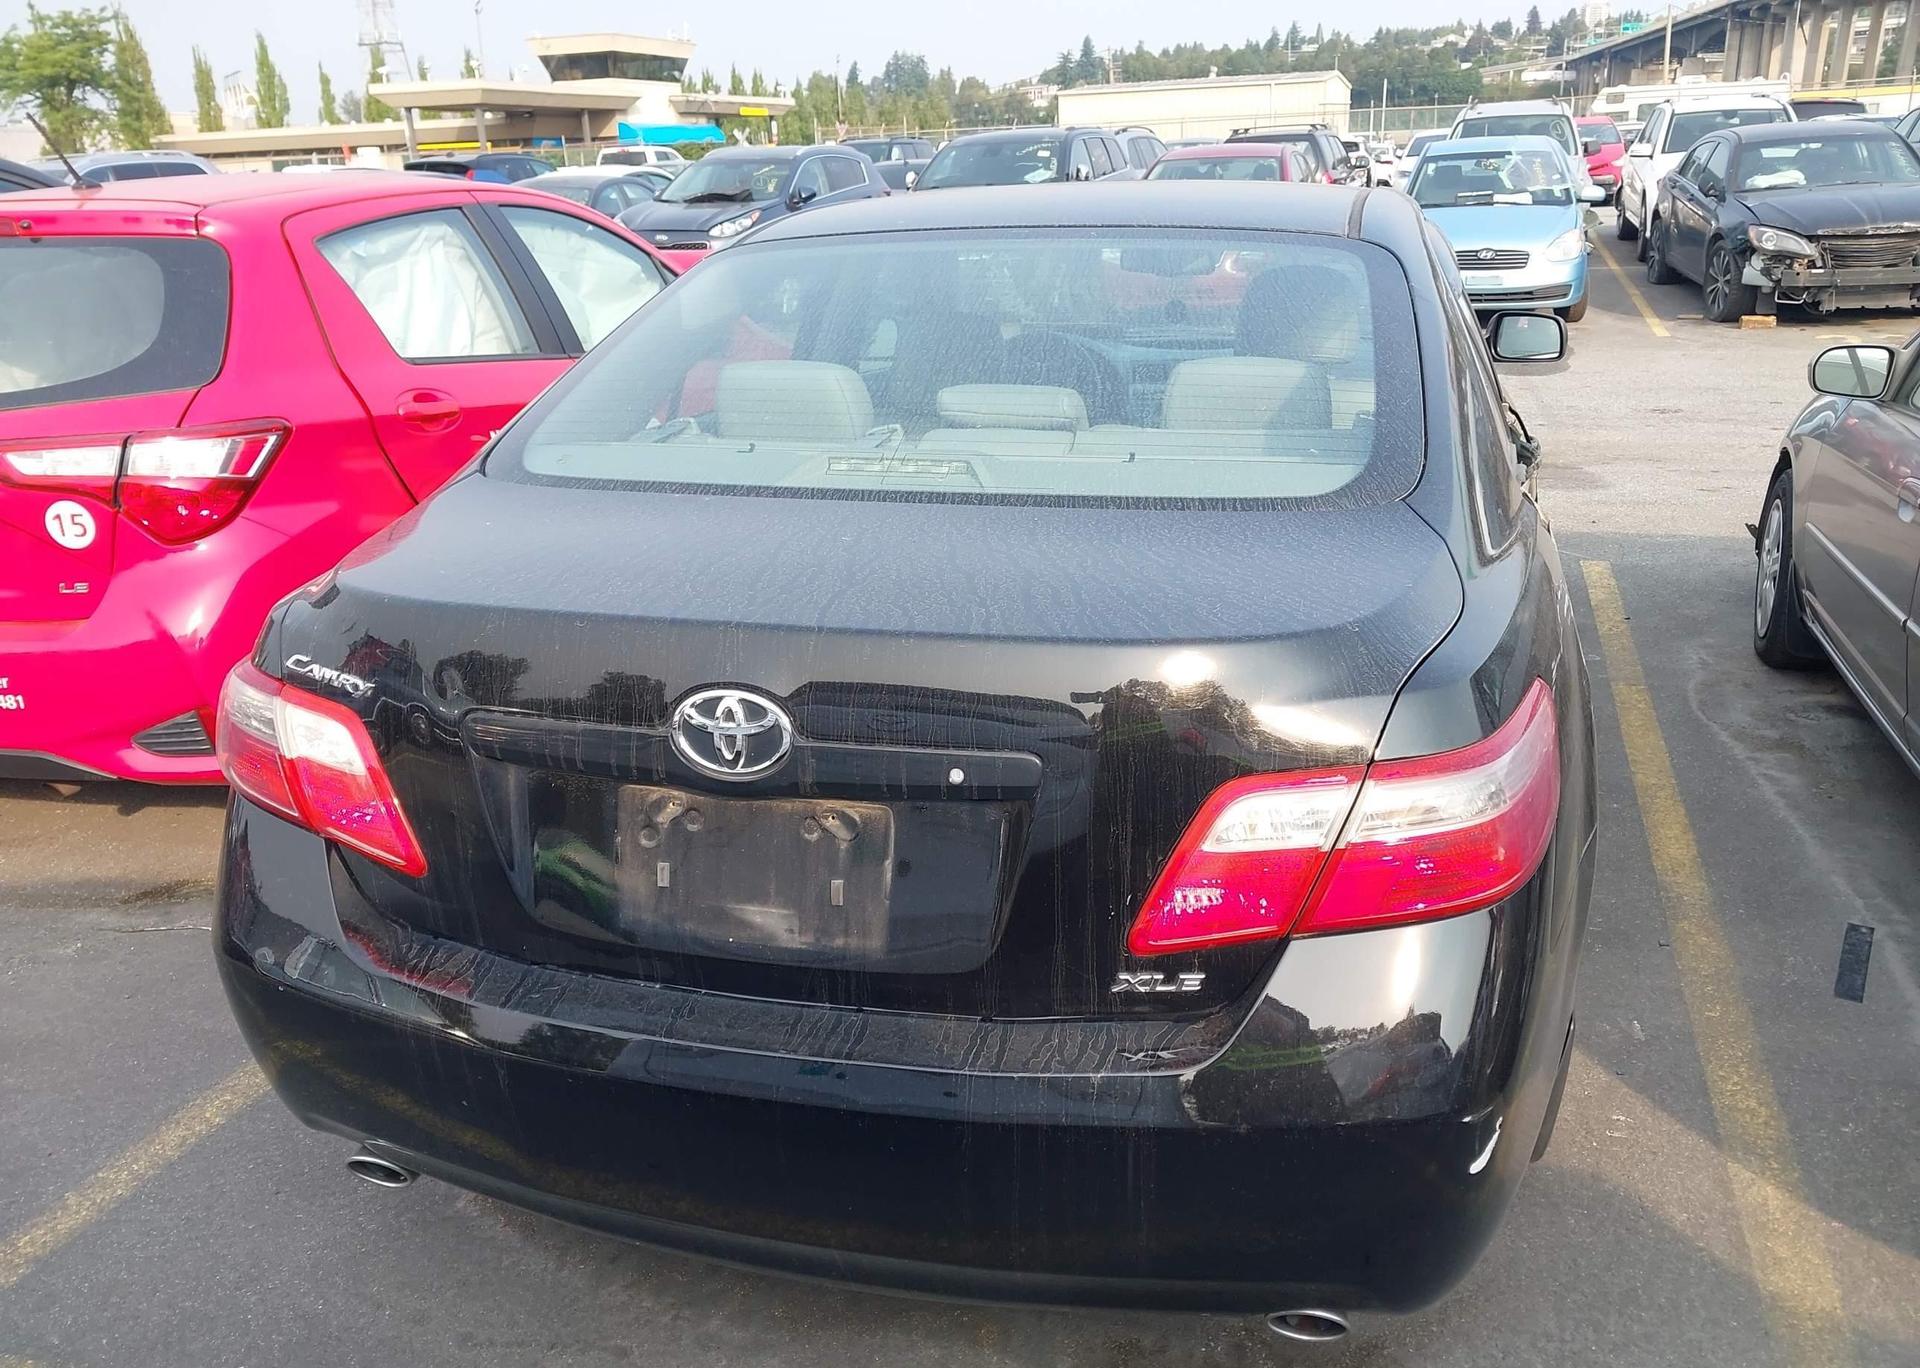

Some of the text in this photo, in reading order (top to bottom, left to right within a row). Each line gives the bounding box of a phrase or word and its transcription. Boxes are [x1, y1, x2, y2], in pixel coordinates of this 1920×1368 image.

[52, 513, 87, 537] 15
[59, 582, 89, 594] LE
[0, 677, 9, 689] r
[284, 654, 376, 698] CAMRY
[1111, 972, 1206, 993] XLE
